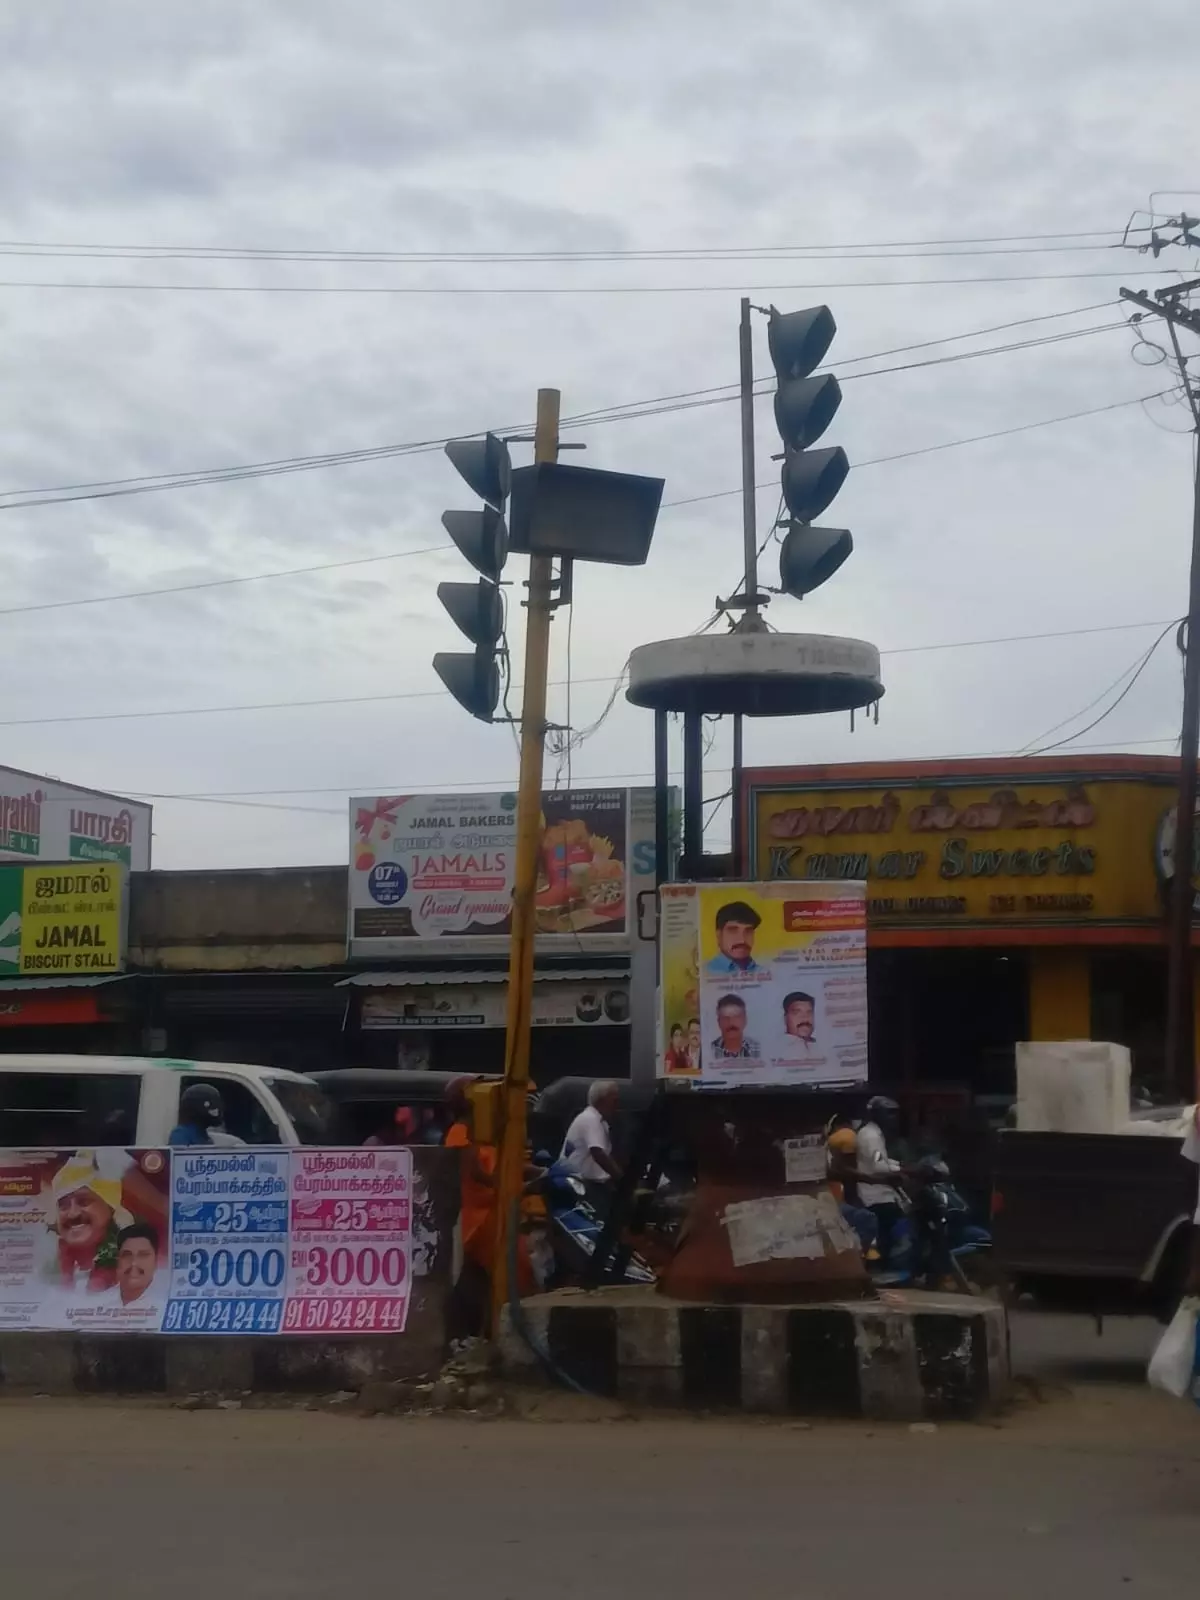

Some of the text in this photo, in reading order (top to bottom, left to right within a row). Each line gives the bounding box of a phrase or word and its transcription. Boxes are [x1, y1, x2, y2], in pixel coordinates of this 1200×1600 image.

[70, 809, 132, 844] பாரதி
[409, 814, 515, 829] JAMAL BAKERS
[411, 853, 506, 877] JAMALS
[769, 838, 1096, 880] Kumar Sweets
[35, 868, 110, 898] ஜமால்
[420, 895, 464, 920] Grand
[36, 924, 106, 948] JAMAL
[24, 953, 116, 970] BISCUIT STALL
[185, 1154, 256, 1177] பூந்தமல்லி
[303, 1153, 375, 1175] பூந்தமல்லி
[176, 1176, 286, 1197] பேரம்பாக்கத்தில்
[294, 1174, 406, 1195] பேரம்பாக்கத்தில்
[214, 1202, 248, 1232] 25
[334, 1200, 368, 1230] 25
[188, 1248, 285, 1287] 3000
[307, 1246, 406, 1286] 3000
[166, 1301, 185, 1329] 91
[185, 1301, 208, 1329] 50
[208, 1301, 231, 1329] 24
[232, 1301, 256, 1329] 24
[256, 1302, 280, 1329] 44
[286, 1299, 402, 1328] 91 50 24 24 44
